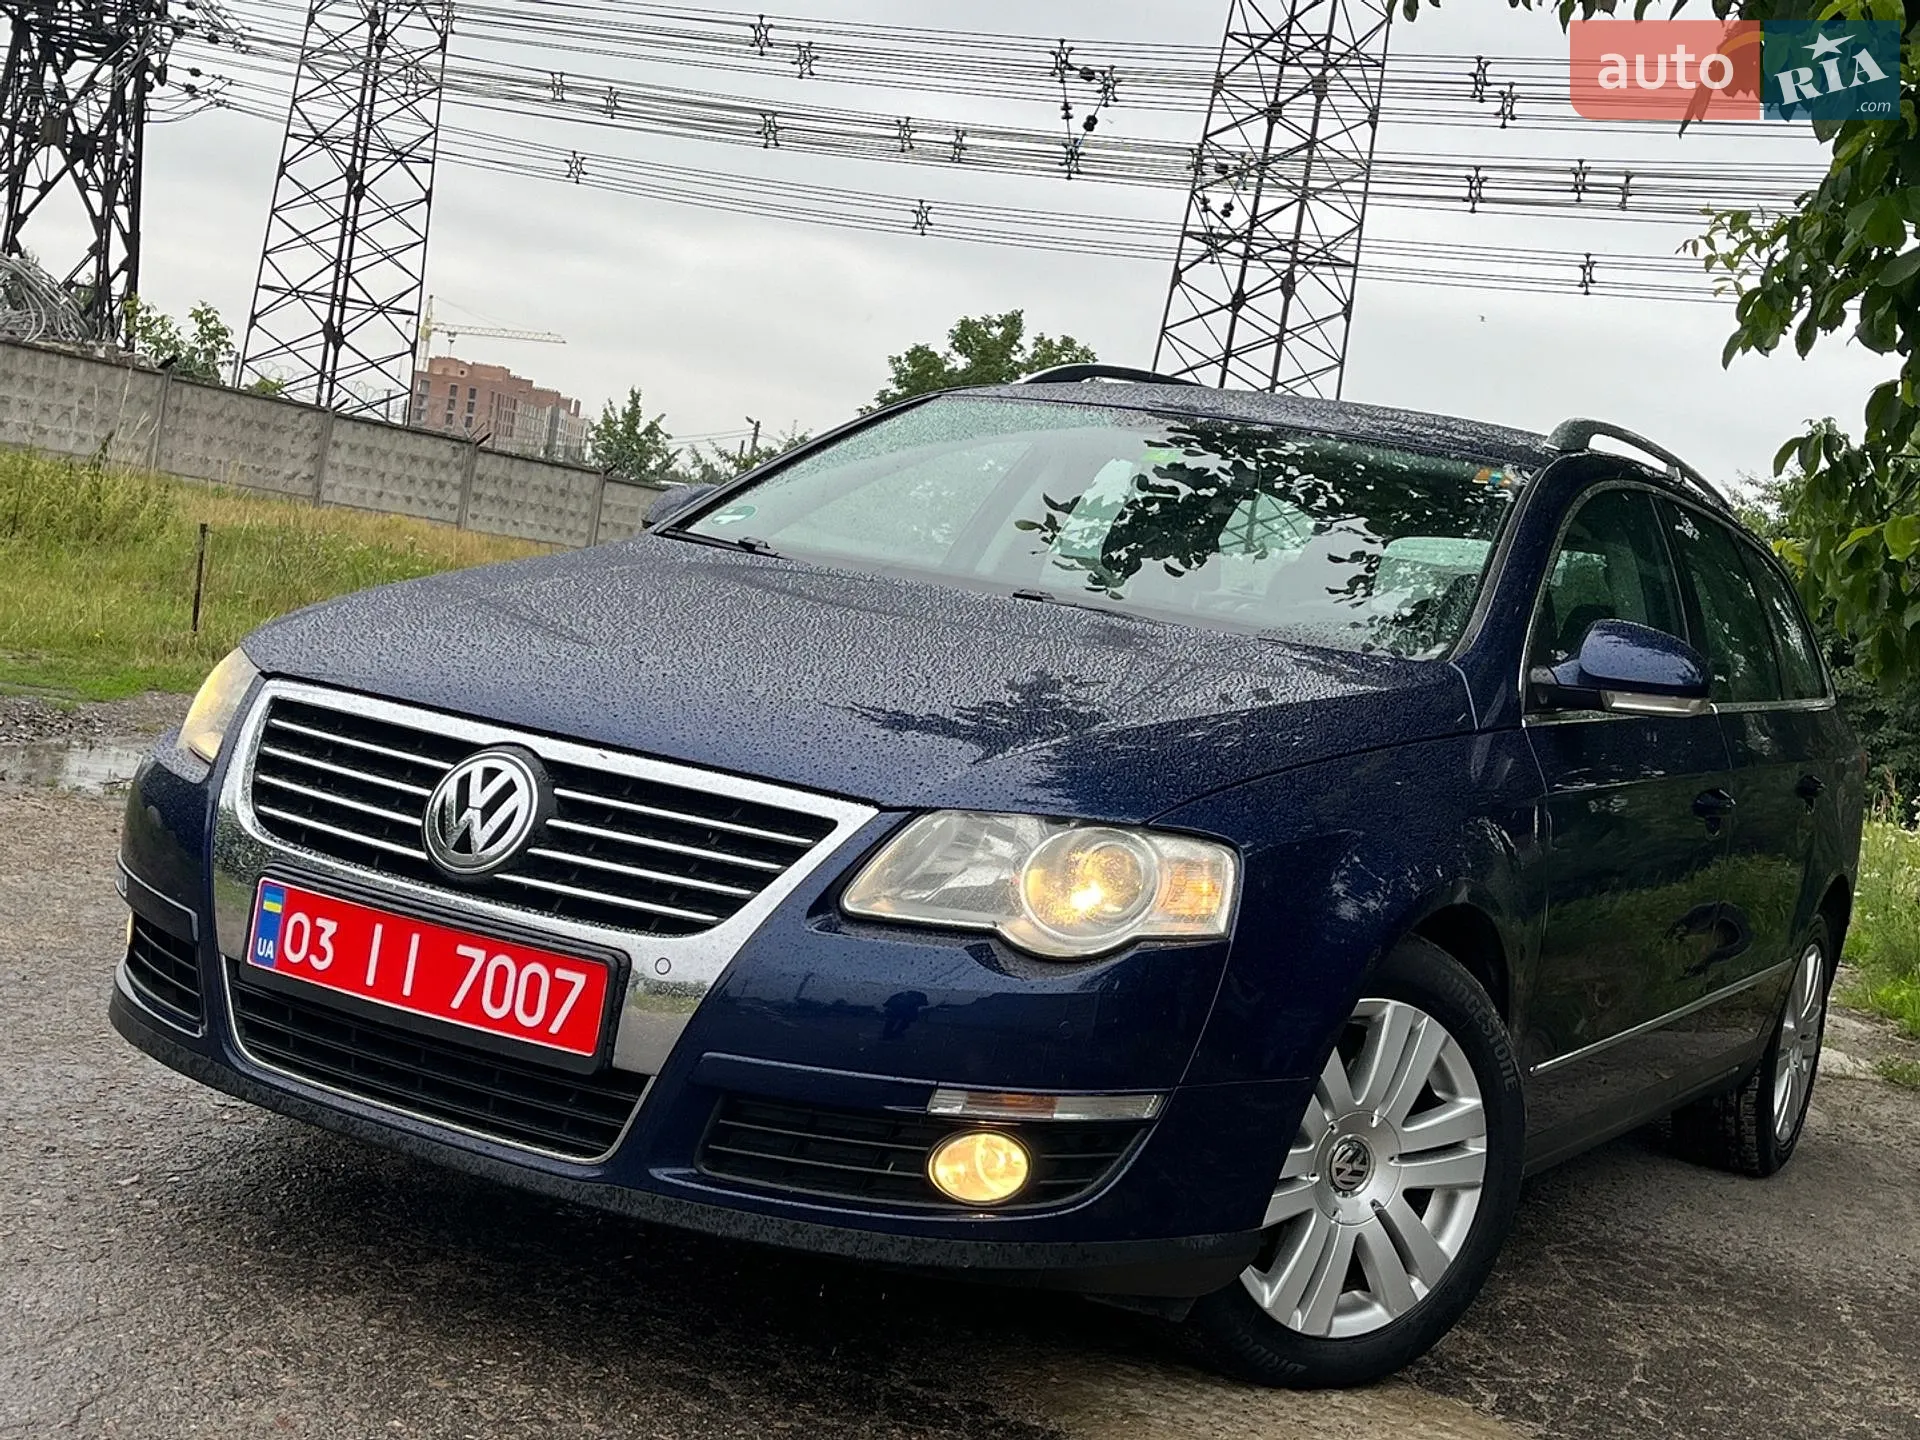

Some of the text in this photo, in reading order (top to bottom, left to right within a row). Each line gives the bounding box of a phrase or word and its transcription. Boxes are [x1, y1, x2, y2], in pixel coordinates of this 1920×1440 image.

[256, 936, 275, 960] UA
[283, 911, 338, 971] 03
[449, 943, 587, 1035] 7007
